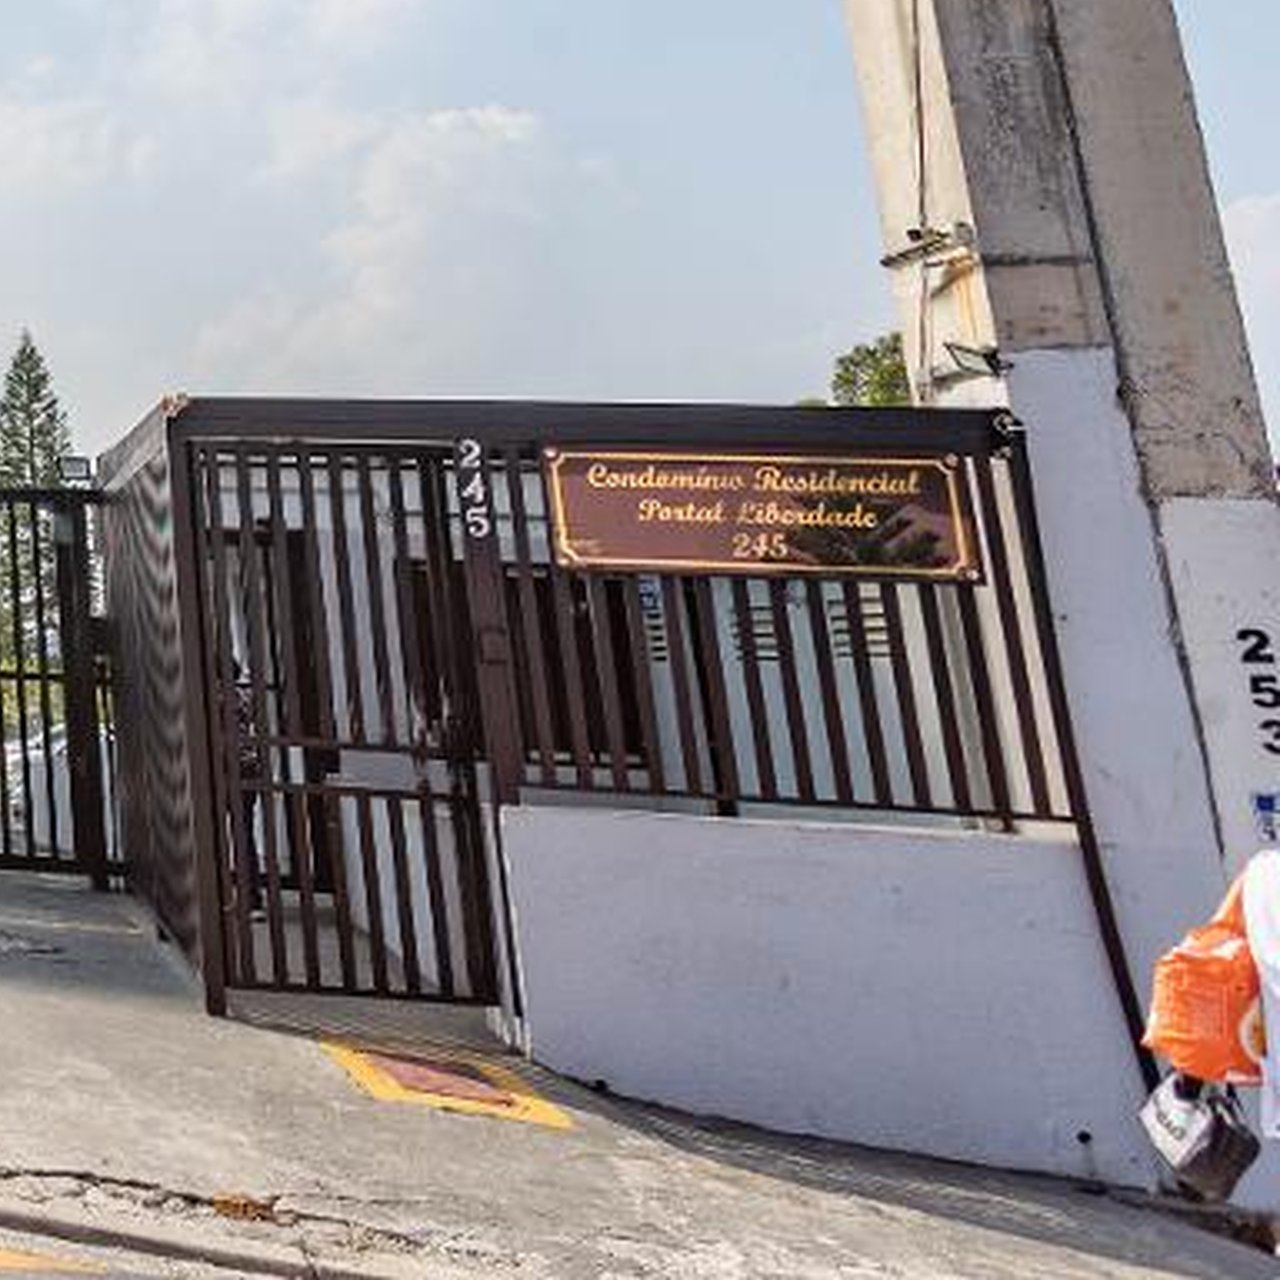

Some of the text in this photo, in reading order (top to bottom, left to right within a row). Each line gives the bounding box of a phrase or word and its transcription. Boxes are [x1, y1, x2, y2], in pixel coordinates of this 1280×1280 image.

[459, 439, 489, 538] 245
[754, 466, 921, 493] Residencial
[638, 499, 878, 528] Portal Liberdade
[731, 532, 788, 558] 245
